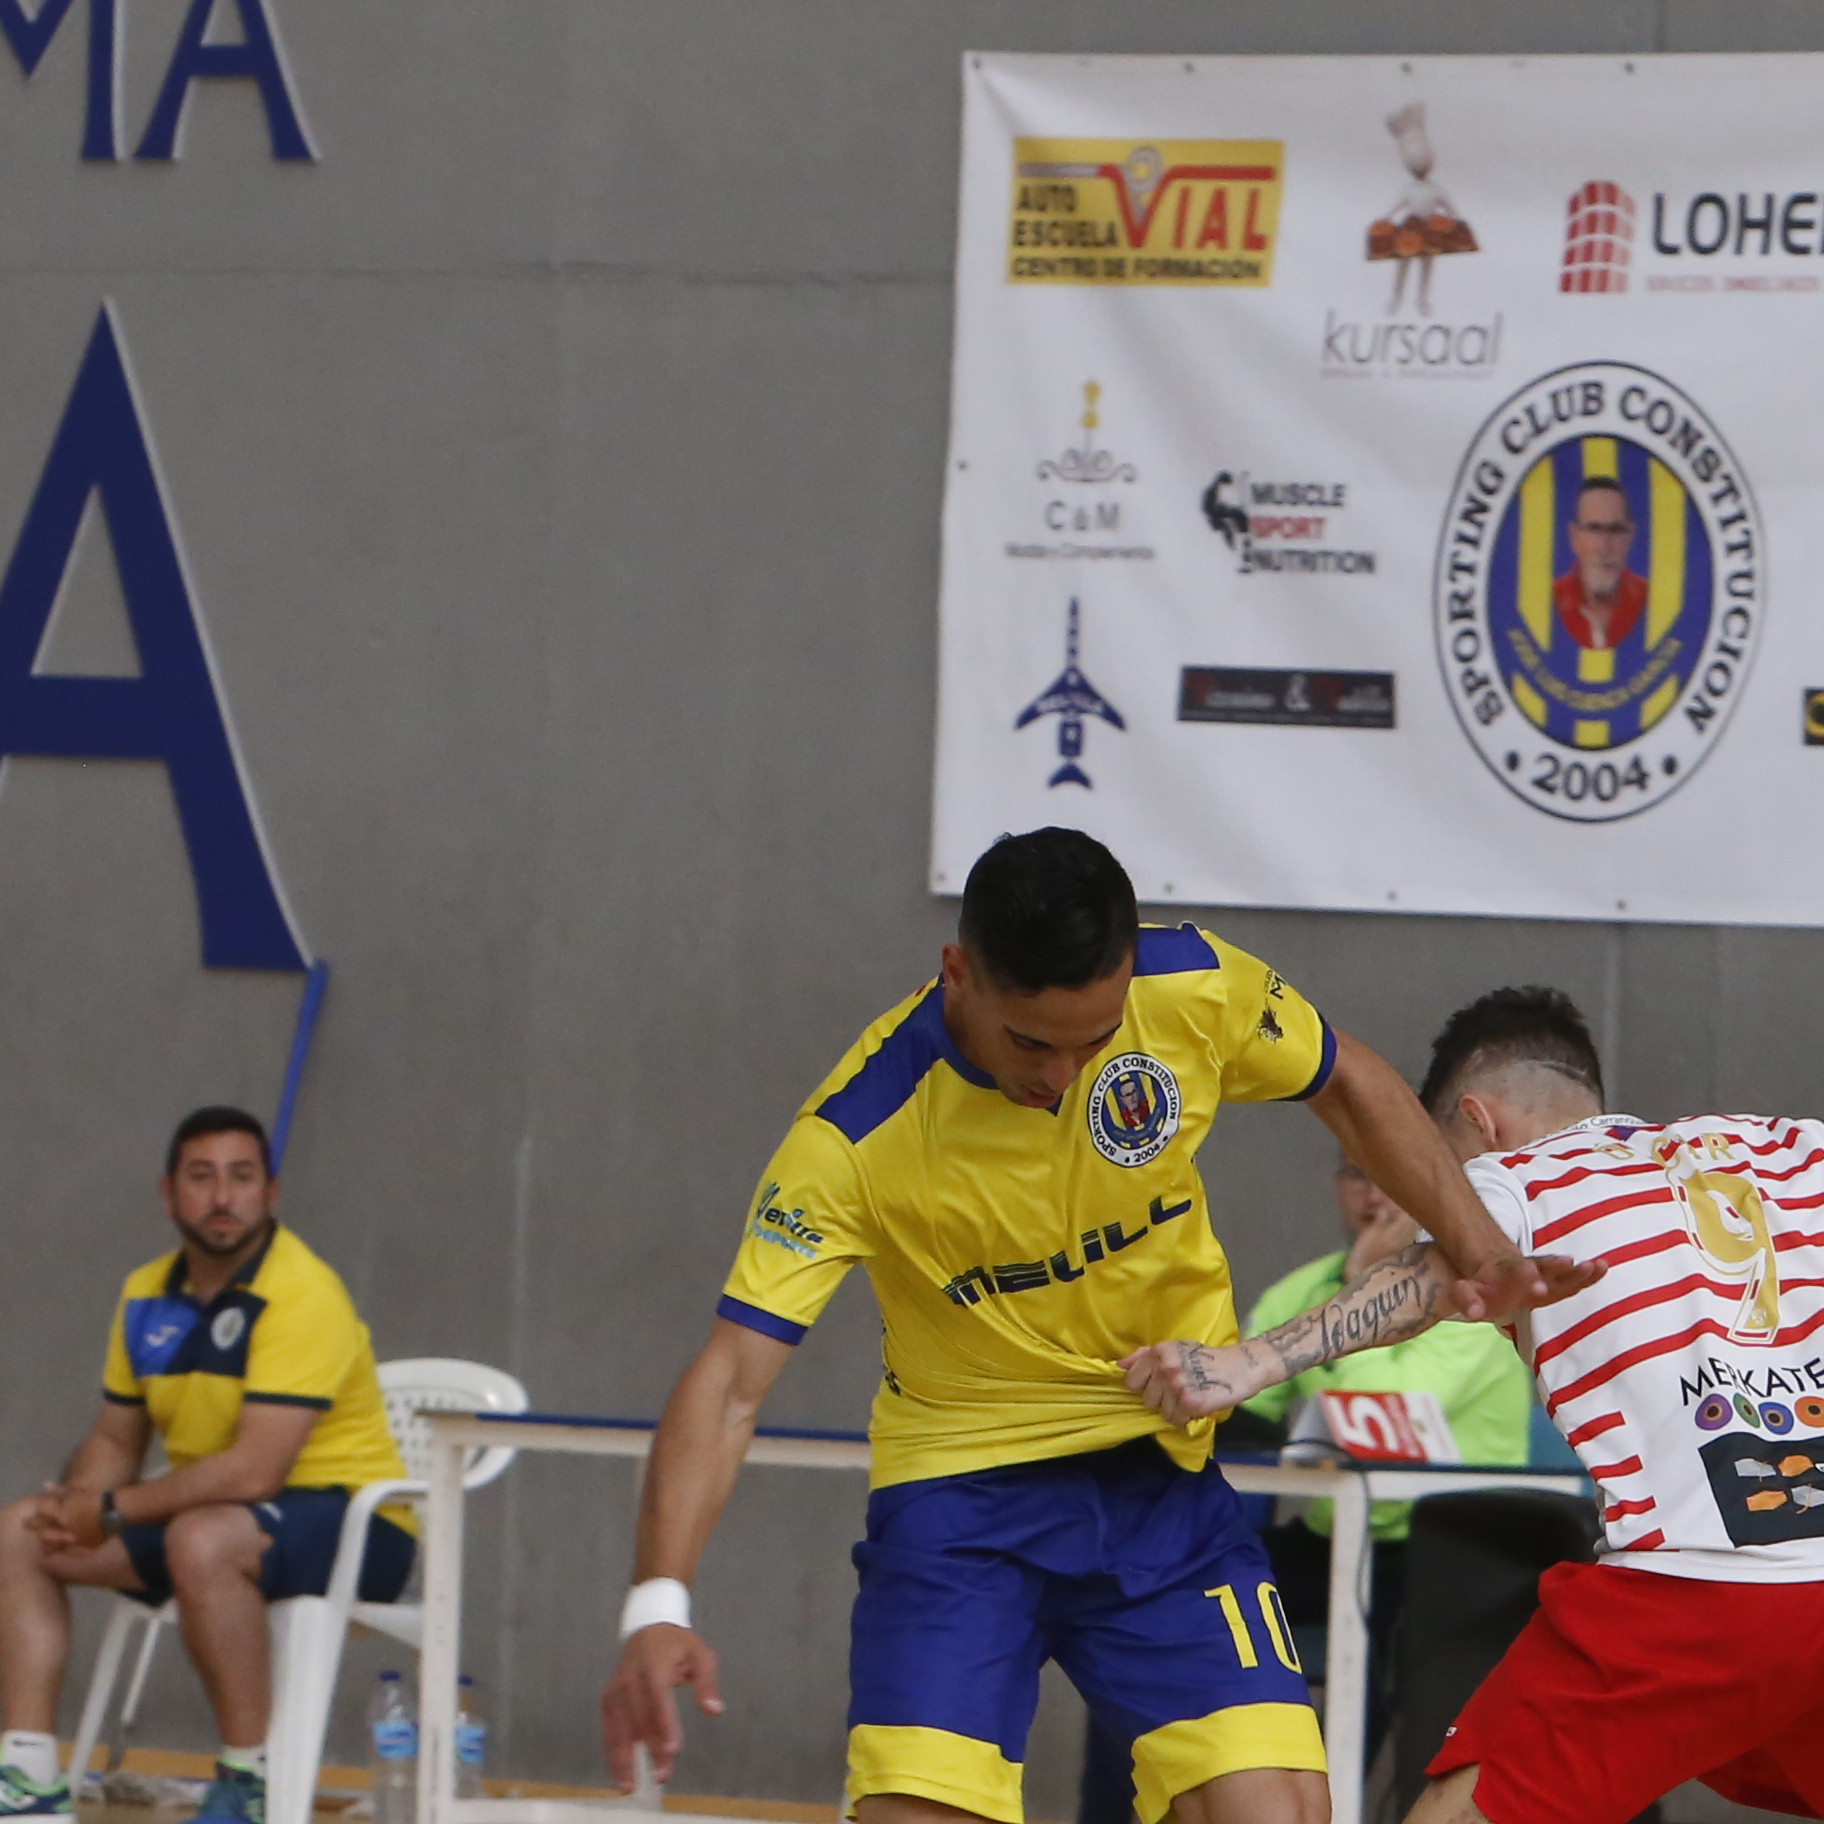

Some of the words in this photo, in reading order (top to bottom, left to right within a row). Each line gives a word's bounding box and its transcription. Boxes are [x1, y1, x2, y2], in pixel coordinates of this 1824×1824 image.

[1012, 220, 1119, 248] ESCUELA
[1015, 184, 1076, 213] AUTO
[1100, 163, 1276, 252] VIAL
[1321, 306, 1505, 367] kursaal
[1251, 516, 1327, 540] SPORT
[1448, 460, 1506, 727] SPORTING
[1500, 381, 1605, 455] CLUB
[1252, 549, 1376, 575] NUTRITION
[1530, 752, 1650, 802] 2004
[1097, 1061, 1121, 1092] CLUB
[1091, 1096, 1117, 1157] SPORTING
[1133, 1143, 1161, 1163] 2004
[1664, 1167, 1781, 1345] 9
[1203, 1580, 1304, 1675] 10
